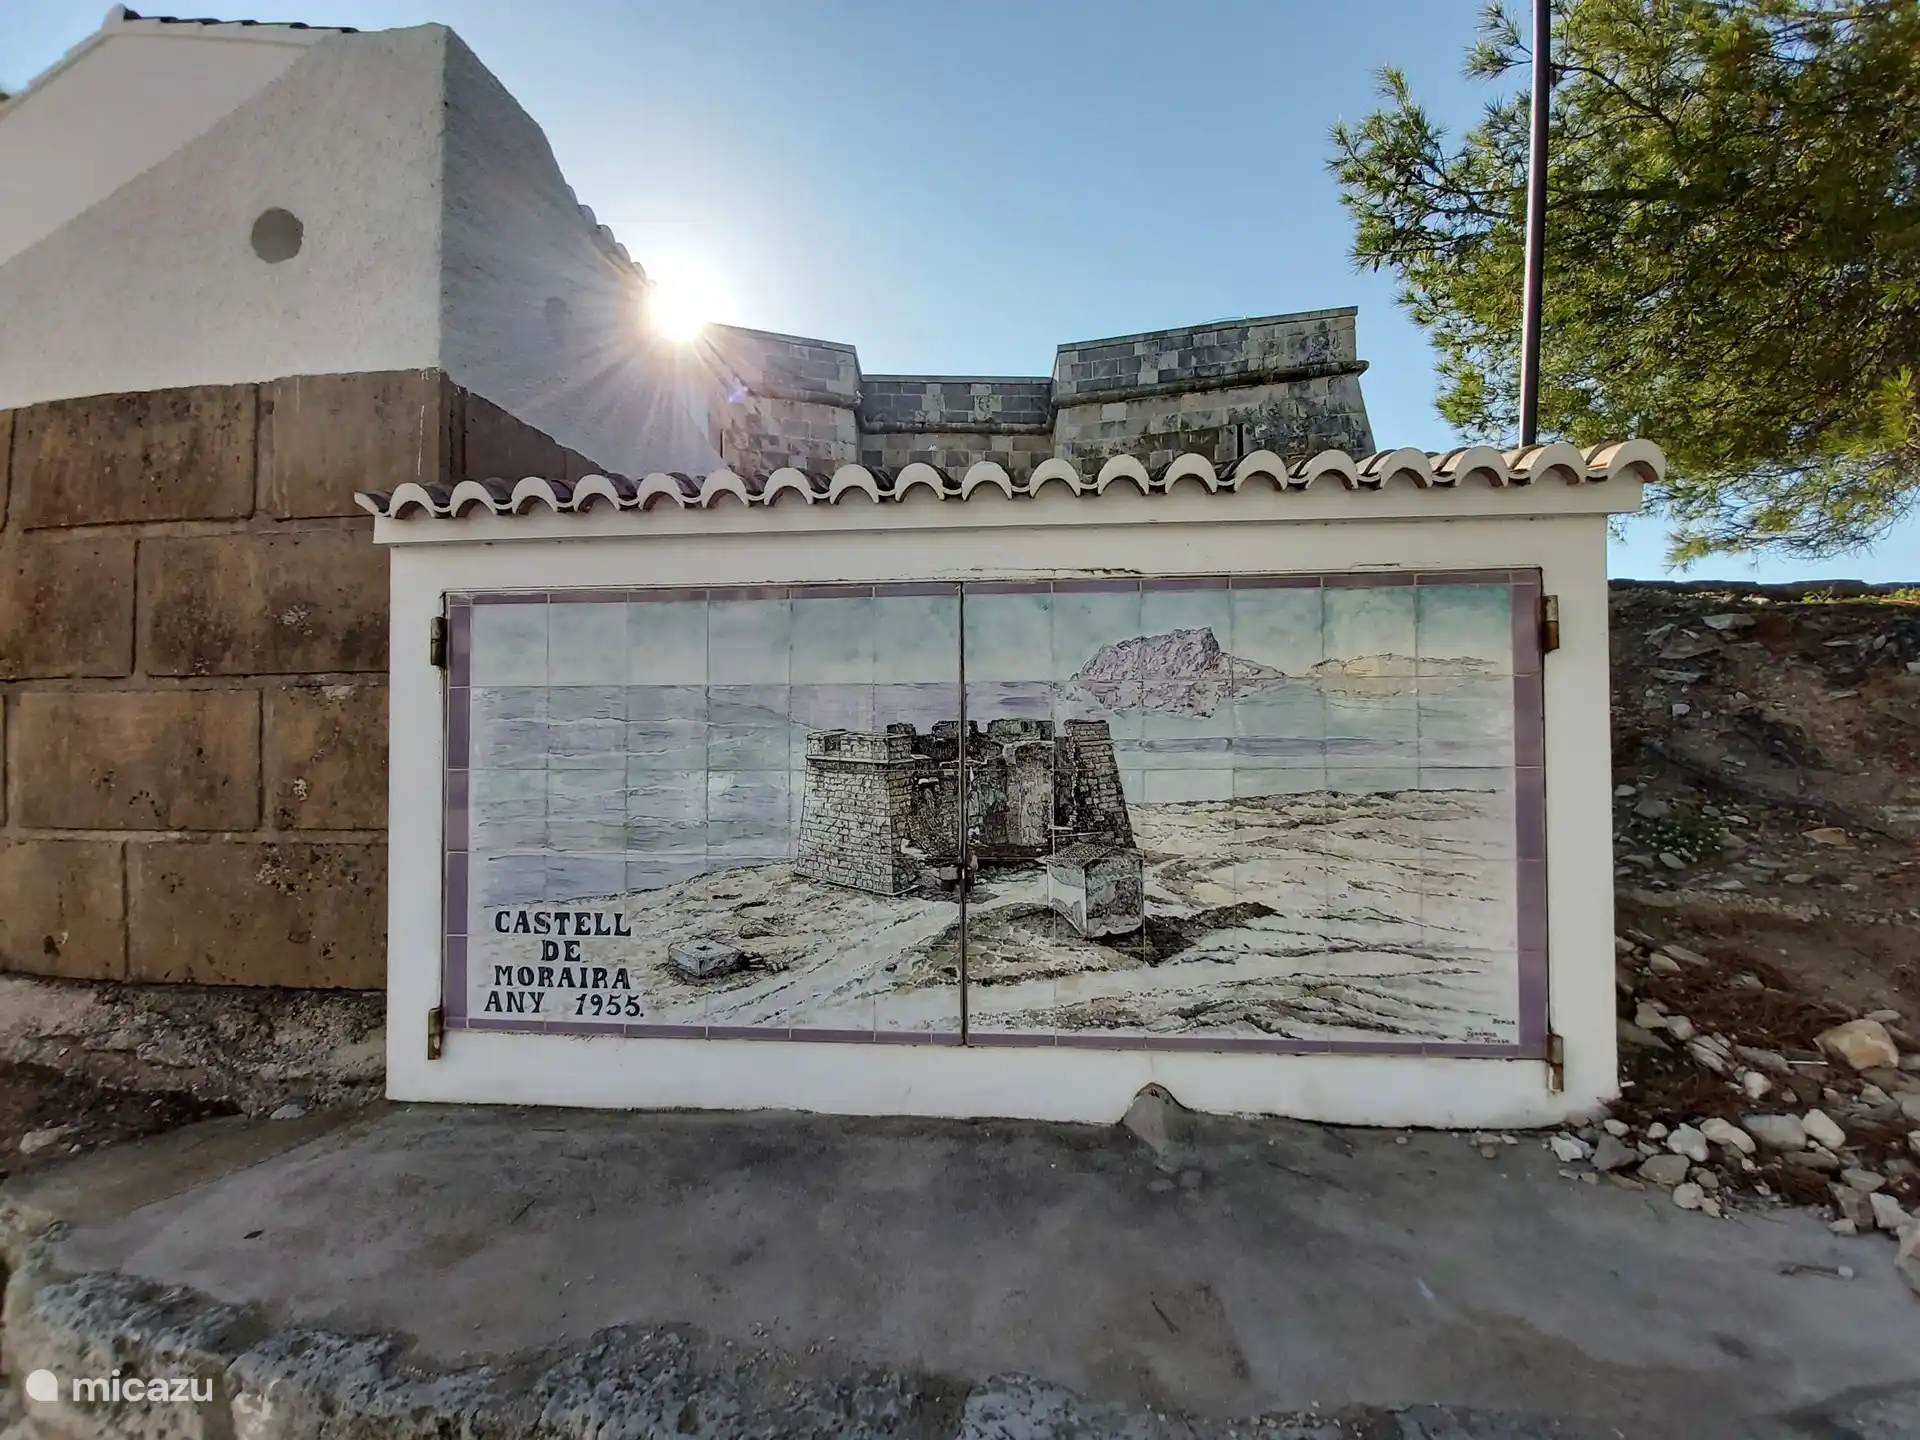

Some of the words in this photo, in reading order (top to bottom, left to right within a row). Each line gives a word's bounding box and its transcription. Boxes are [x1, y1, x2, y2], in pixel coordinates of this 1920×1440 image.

[494, 910, 632, 936] CASTELL
[541, 939, 581, 962] DE
[494, 965, 631, 990] MORAIRA
[484, 990, 545, 1014] ANY
[574, 992, 645, 1018] 1955.
